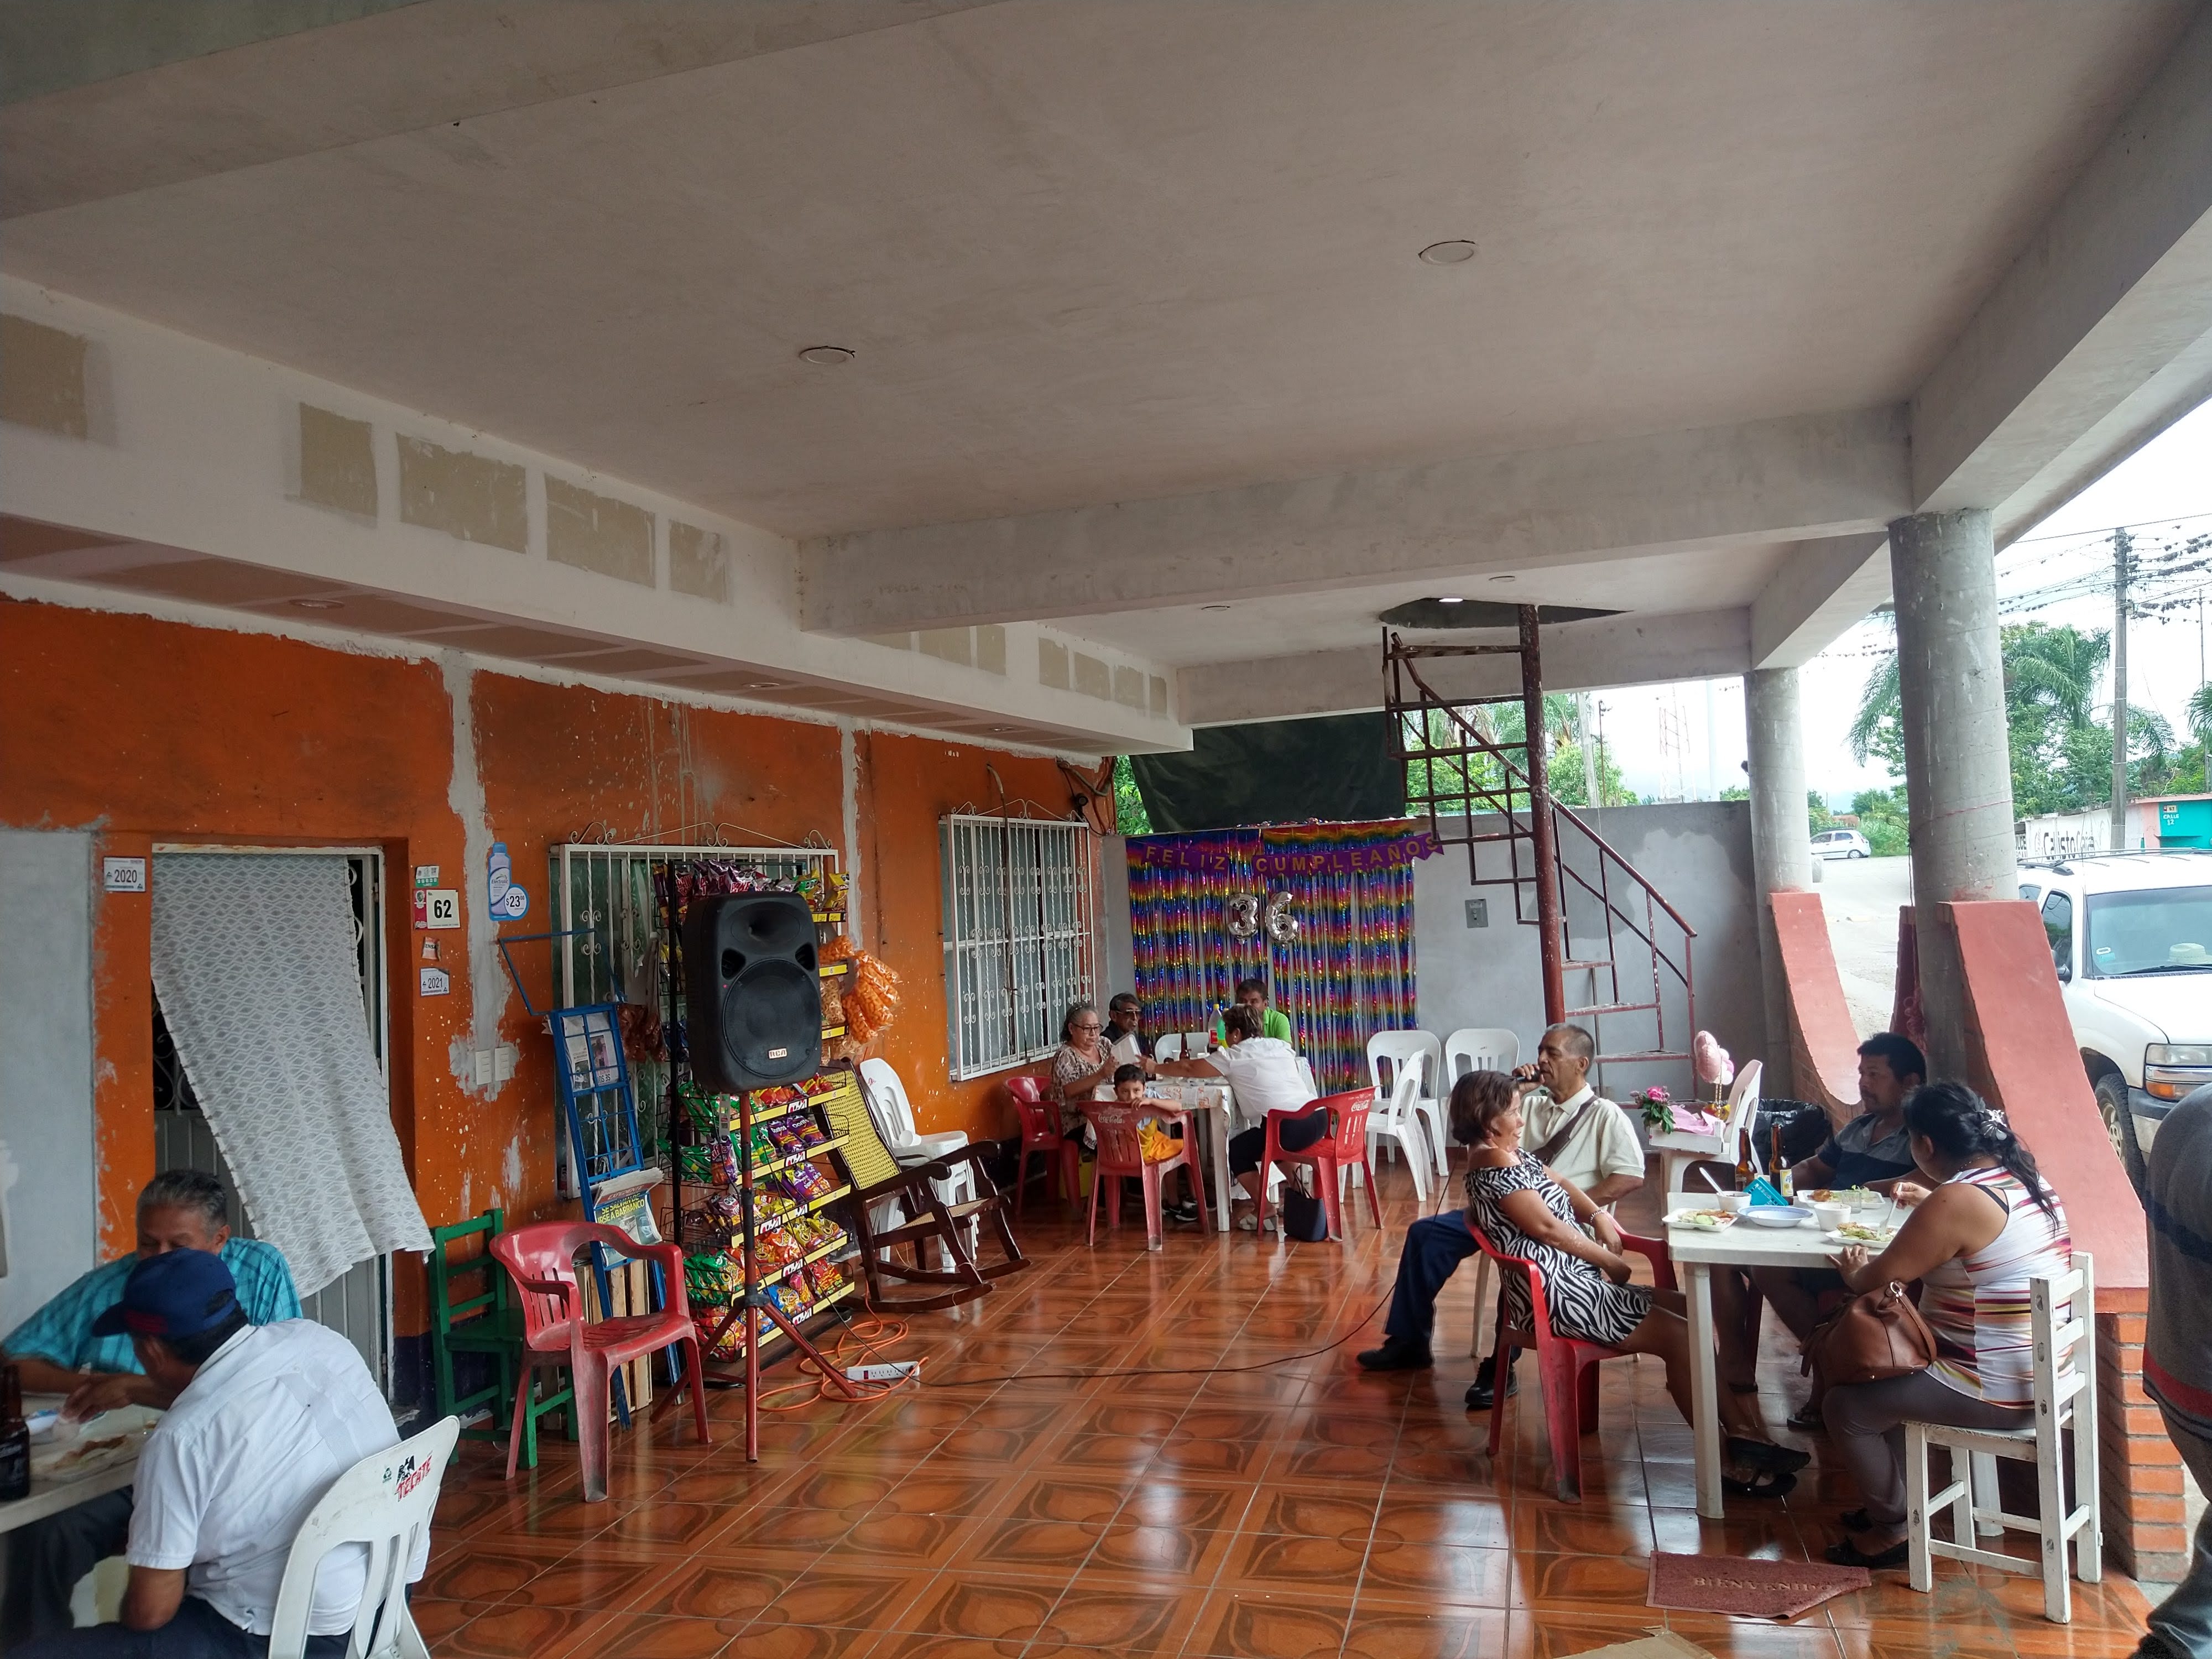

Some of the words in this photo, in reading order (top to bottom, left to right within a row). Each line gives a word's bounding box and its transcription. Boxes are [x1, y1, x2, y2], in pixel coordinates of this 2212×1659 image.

[1146, 846, 1225, 870] FELIZ
[1256, 836, 1438, 873] CUMPLEAÑOS
[114, 869, 137, 883] 2020
[434, 899, 452, 919] 62
[427, 977, 442, 989] 2021
[597, 1213, 610, 1224] IRSE
[611, 1211, 616, 1220] A
[615, 1199, 645, 1218] BARRANCO
[395, 1454, 432, 1502] TECATE
